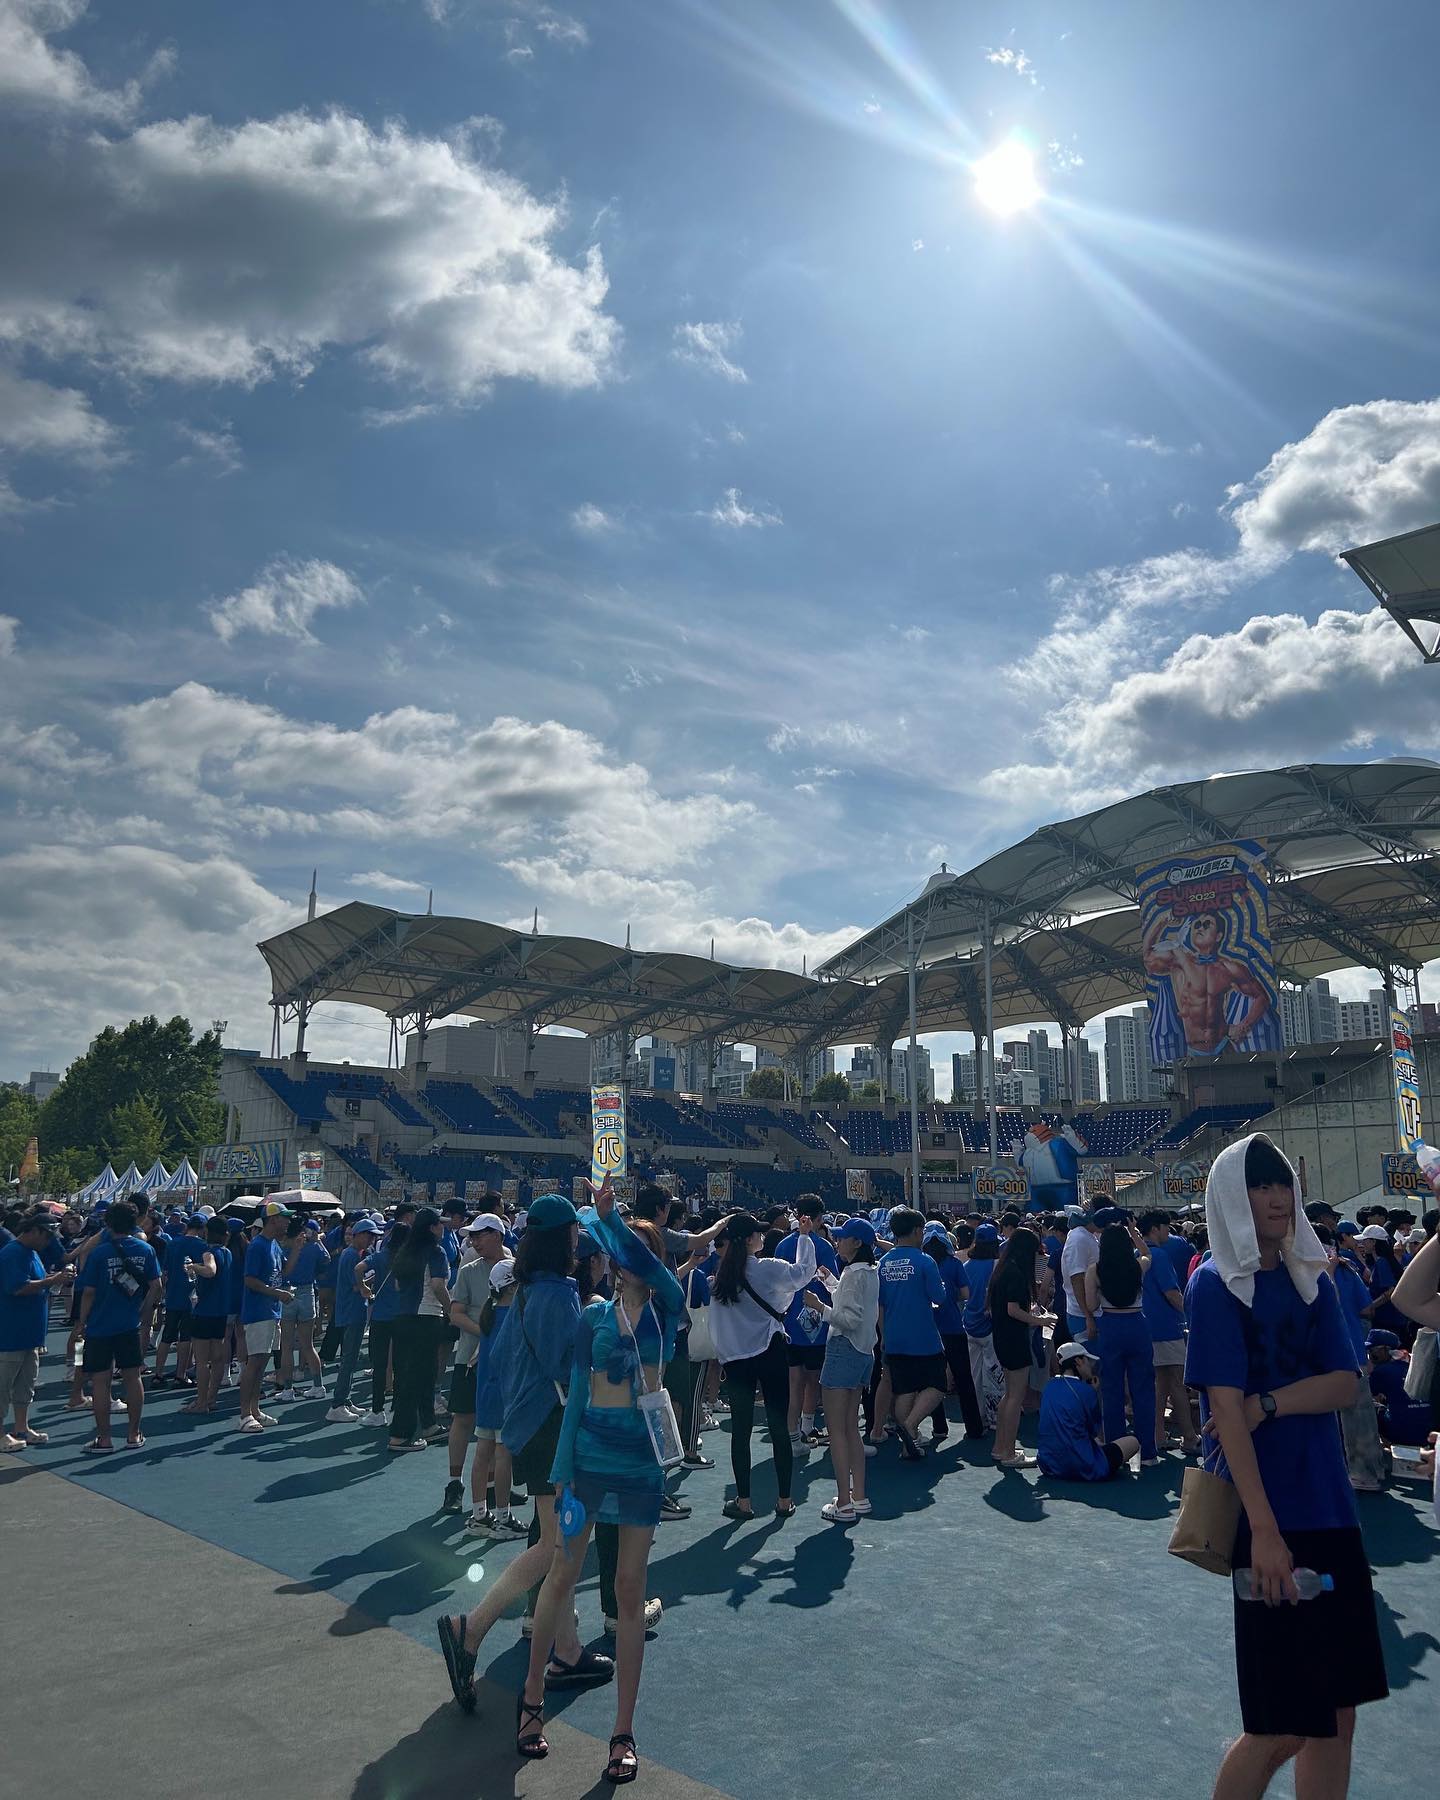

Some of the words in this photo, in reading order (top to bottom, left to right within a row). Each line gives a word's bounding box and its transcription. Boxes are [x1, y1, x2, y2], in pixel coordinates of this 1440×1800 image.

[1188, 891, 1216, 903] 2023
[1387, 1172, 1426, 1189] 1801~
[977, 1180, 1027, 1195] 601~900
[881, 1265, 915, 1276] SUMMER
[886, 1272, 909, 1282] SWAG
